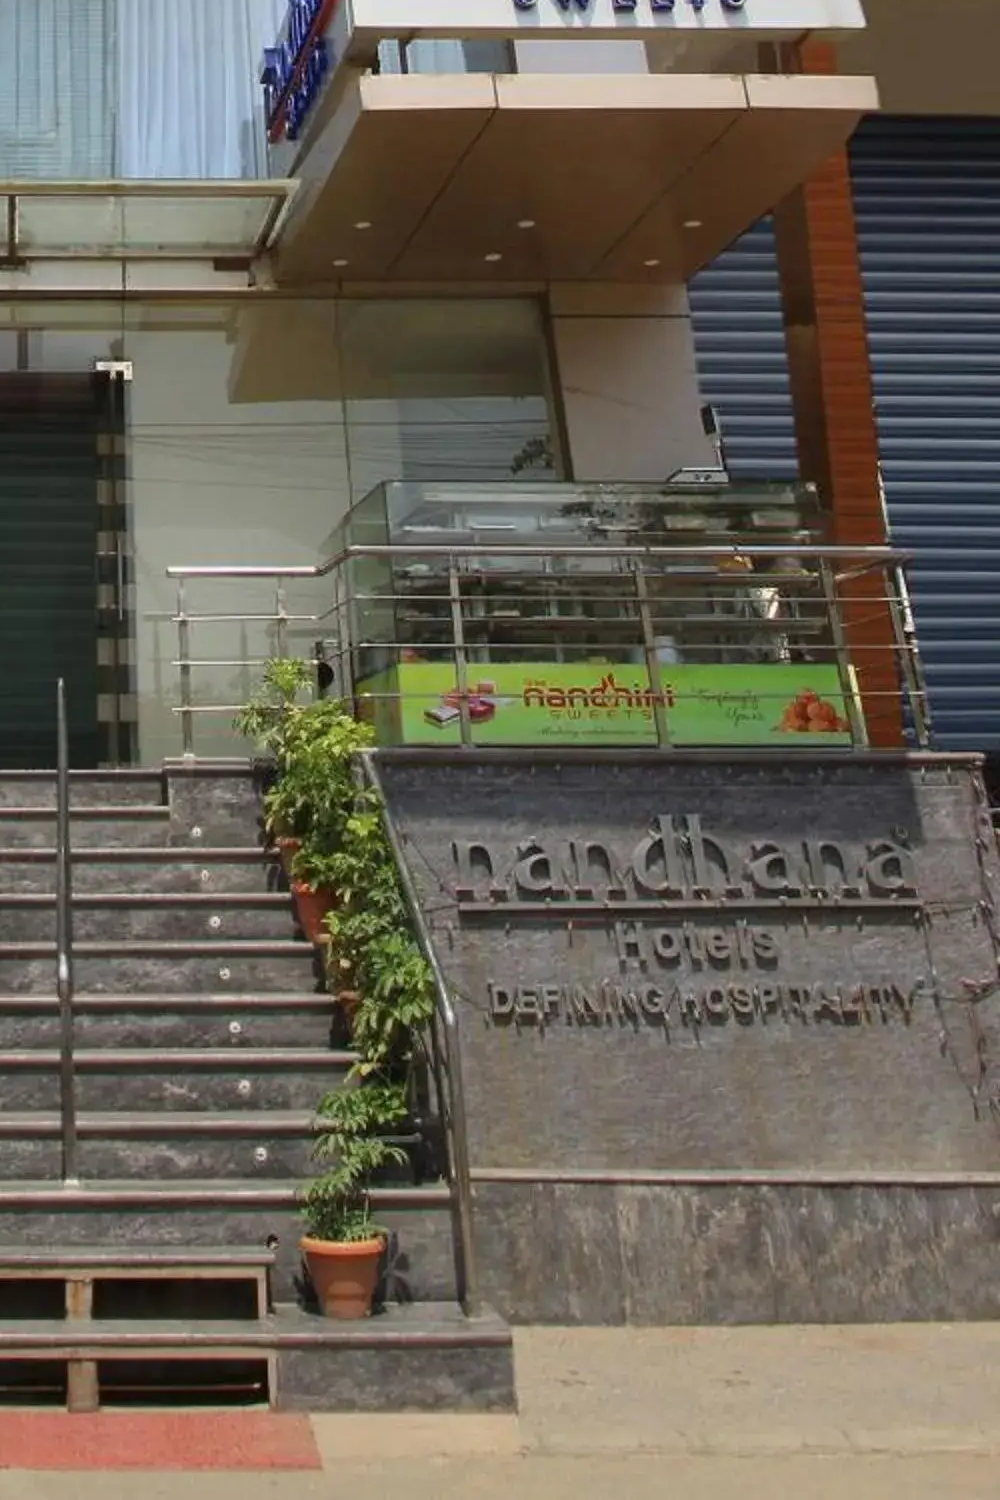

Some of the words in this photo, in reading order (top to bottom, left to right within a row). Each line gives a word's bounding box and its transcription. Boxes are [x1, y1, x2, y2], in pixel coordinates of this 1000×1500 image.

[451, 813, 918, 900] nandhana
[616, 920, 779, 968] Hotels
[489, 982, 667, 1024] DEFINING
